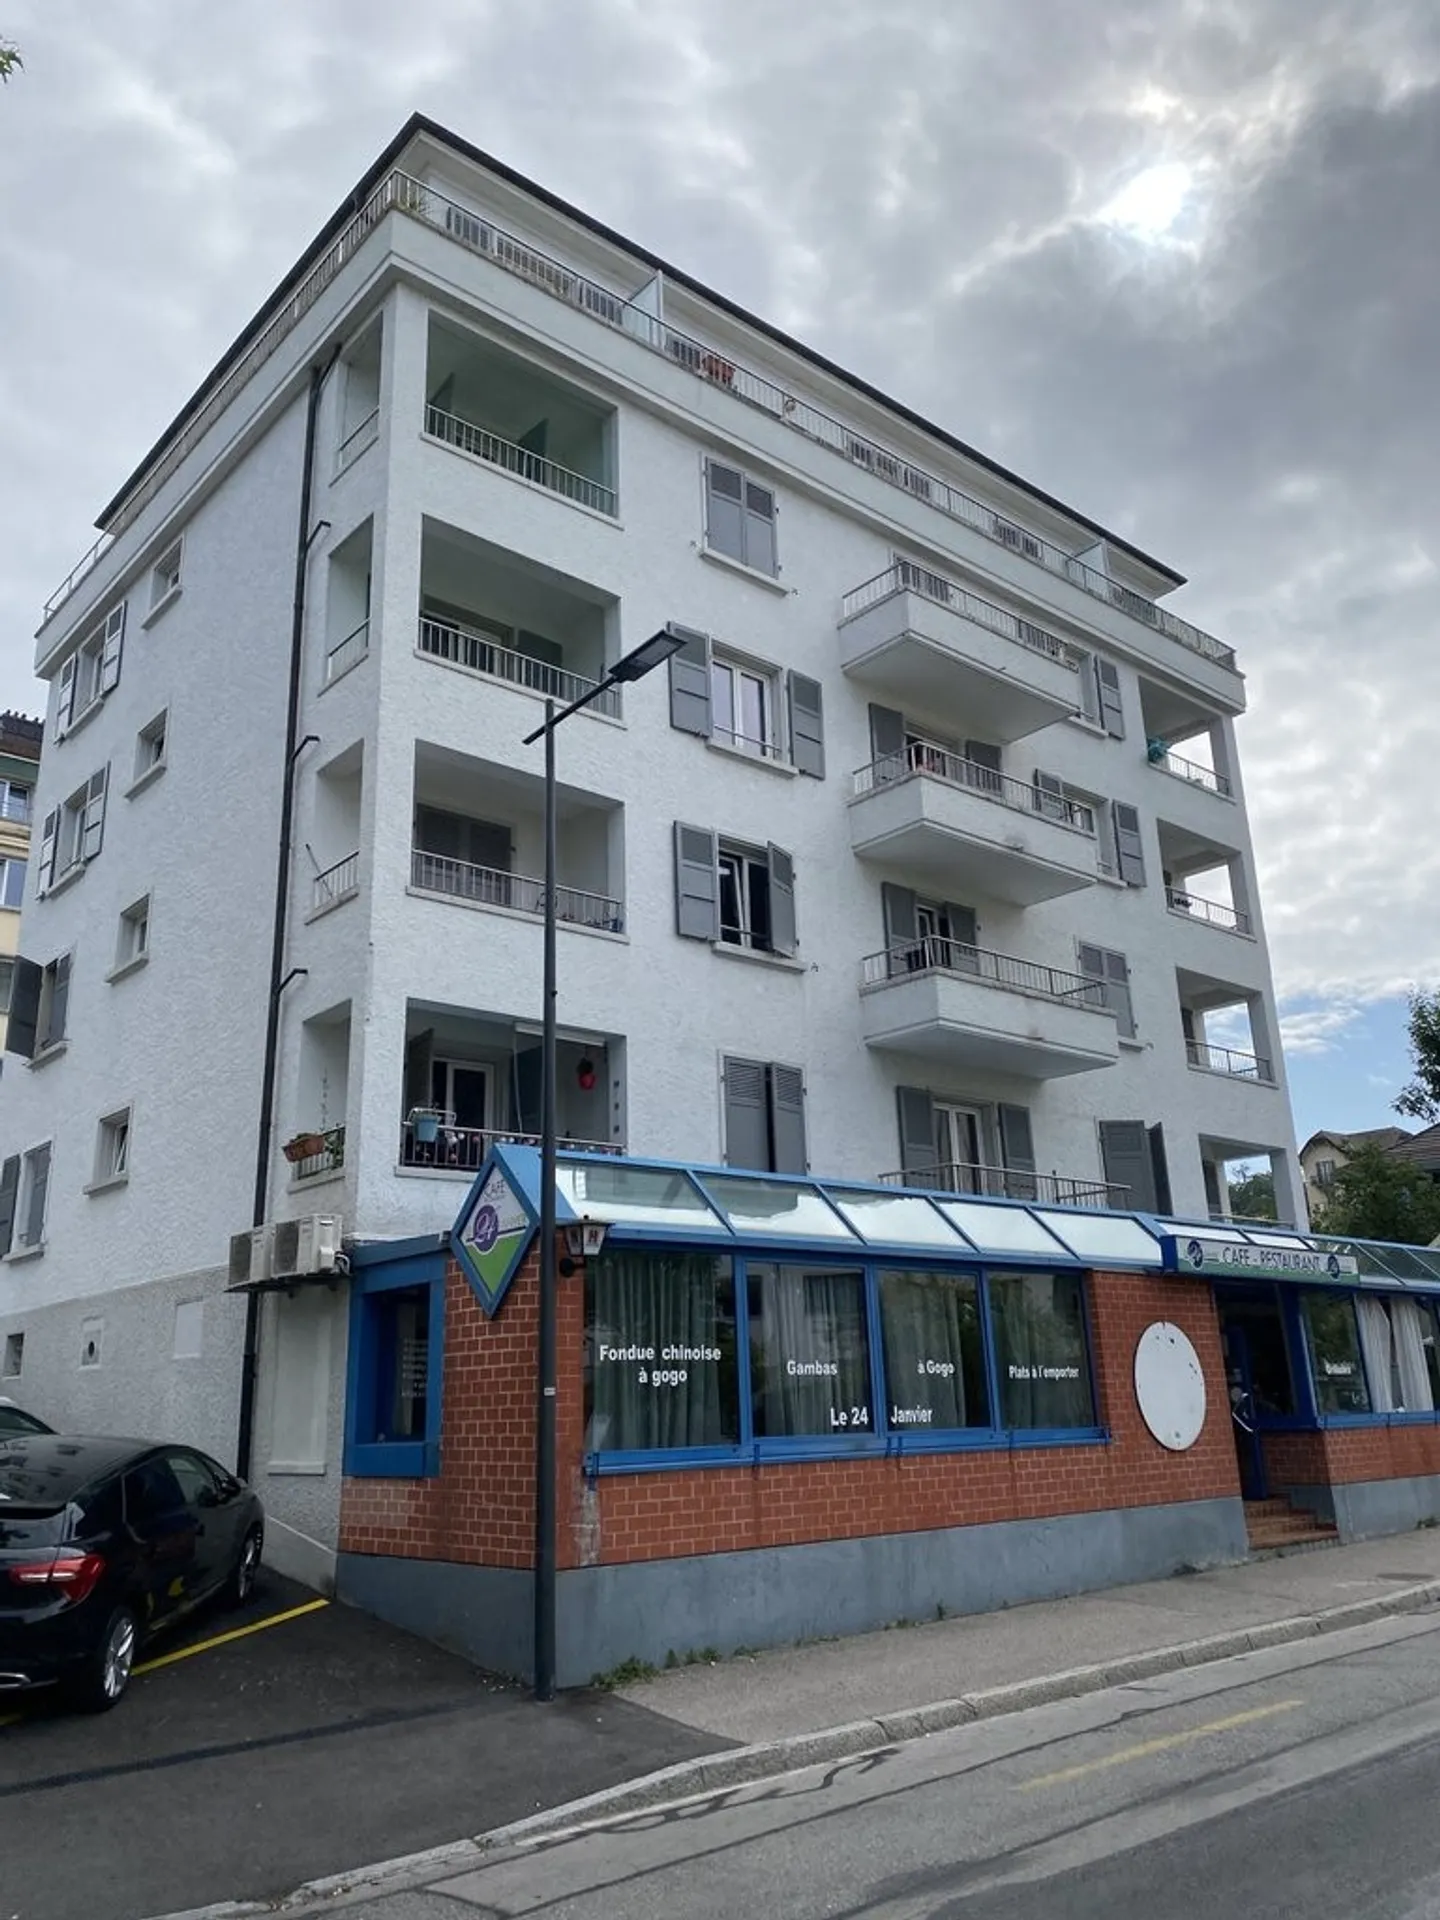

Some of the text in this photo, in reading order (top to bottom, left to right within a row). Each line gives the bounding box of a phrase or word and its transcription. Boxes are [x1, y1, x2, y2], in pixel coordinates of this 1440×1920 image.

[1260, 1250, 1321, 1271] RESTAURANT
[600, 1344, 721, 1361] Fondue chinoise
[638, 1367, 688, 1387] à gogo
[786, 1360, 838, 1376] Gambas
[926, 1361, 955, 1377] Gogo
[1008, 1365, 1030, 1379] Plats
[830, 1405, 933, 1426] Le 24 Janvier
